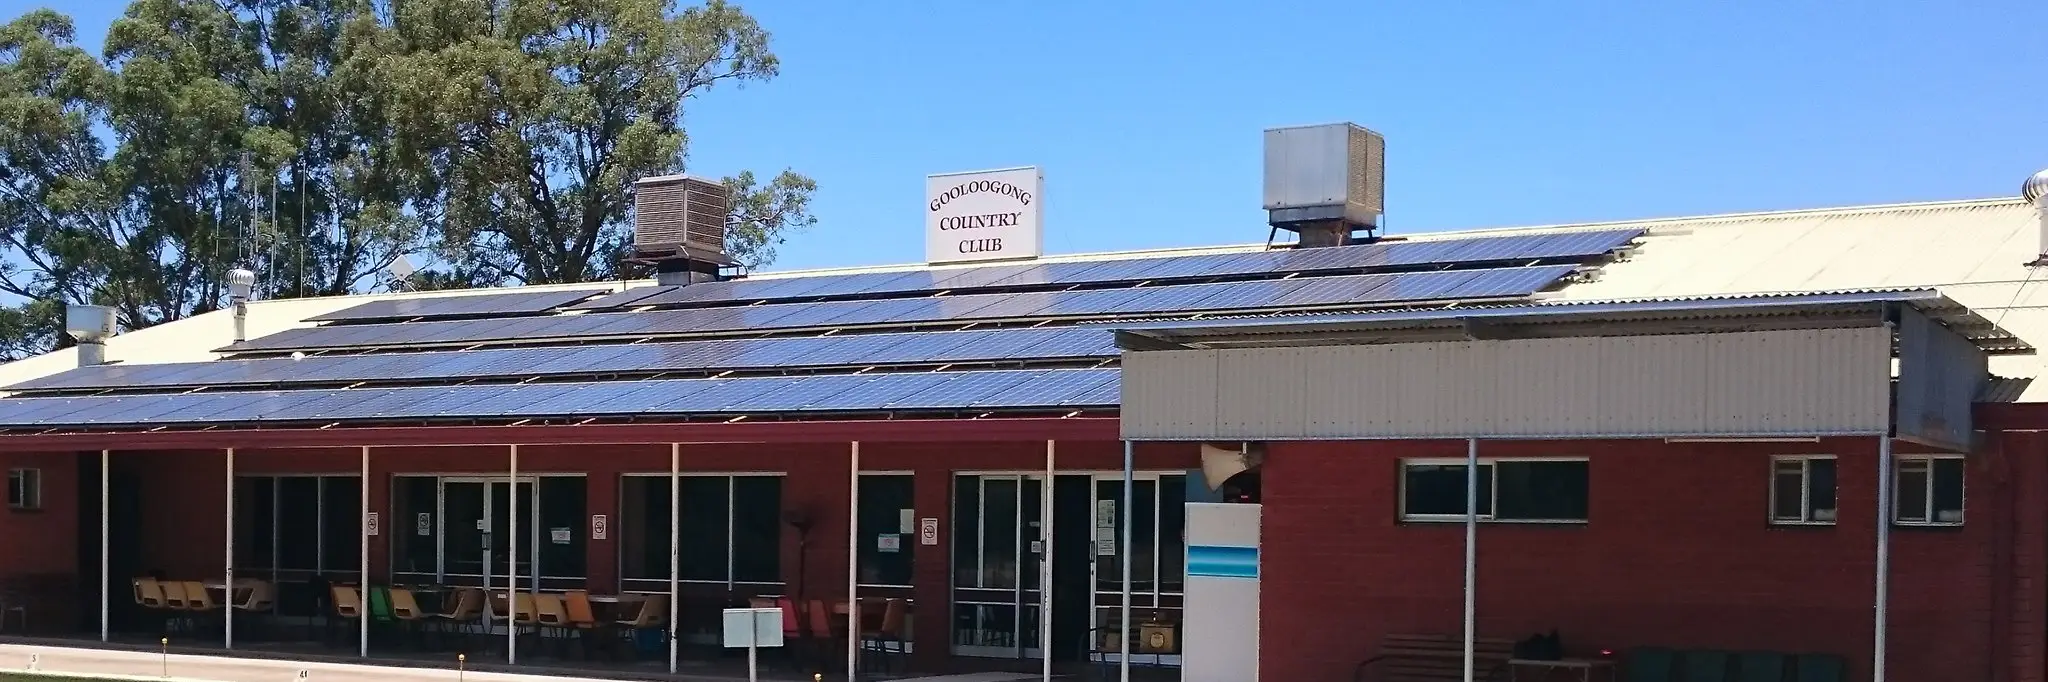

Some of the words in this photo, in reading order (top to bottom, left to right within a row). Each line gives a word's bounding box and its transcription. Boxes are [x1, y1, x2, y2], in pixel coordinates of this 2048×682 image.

[930, 180, 1032, 212] GOOLOOGONG
[939, 211, 1022, 231] COUNTRY
[958, 238, 1003, 254] CLUB
